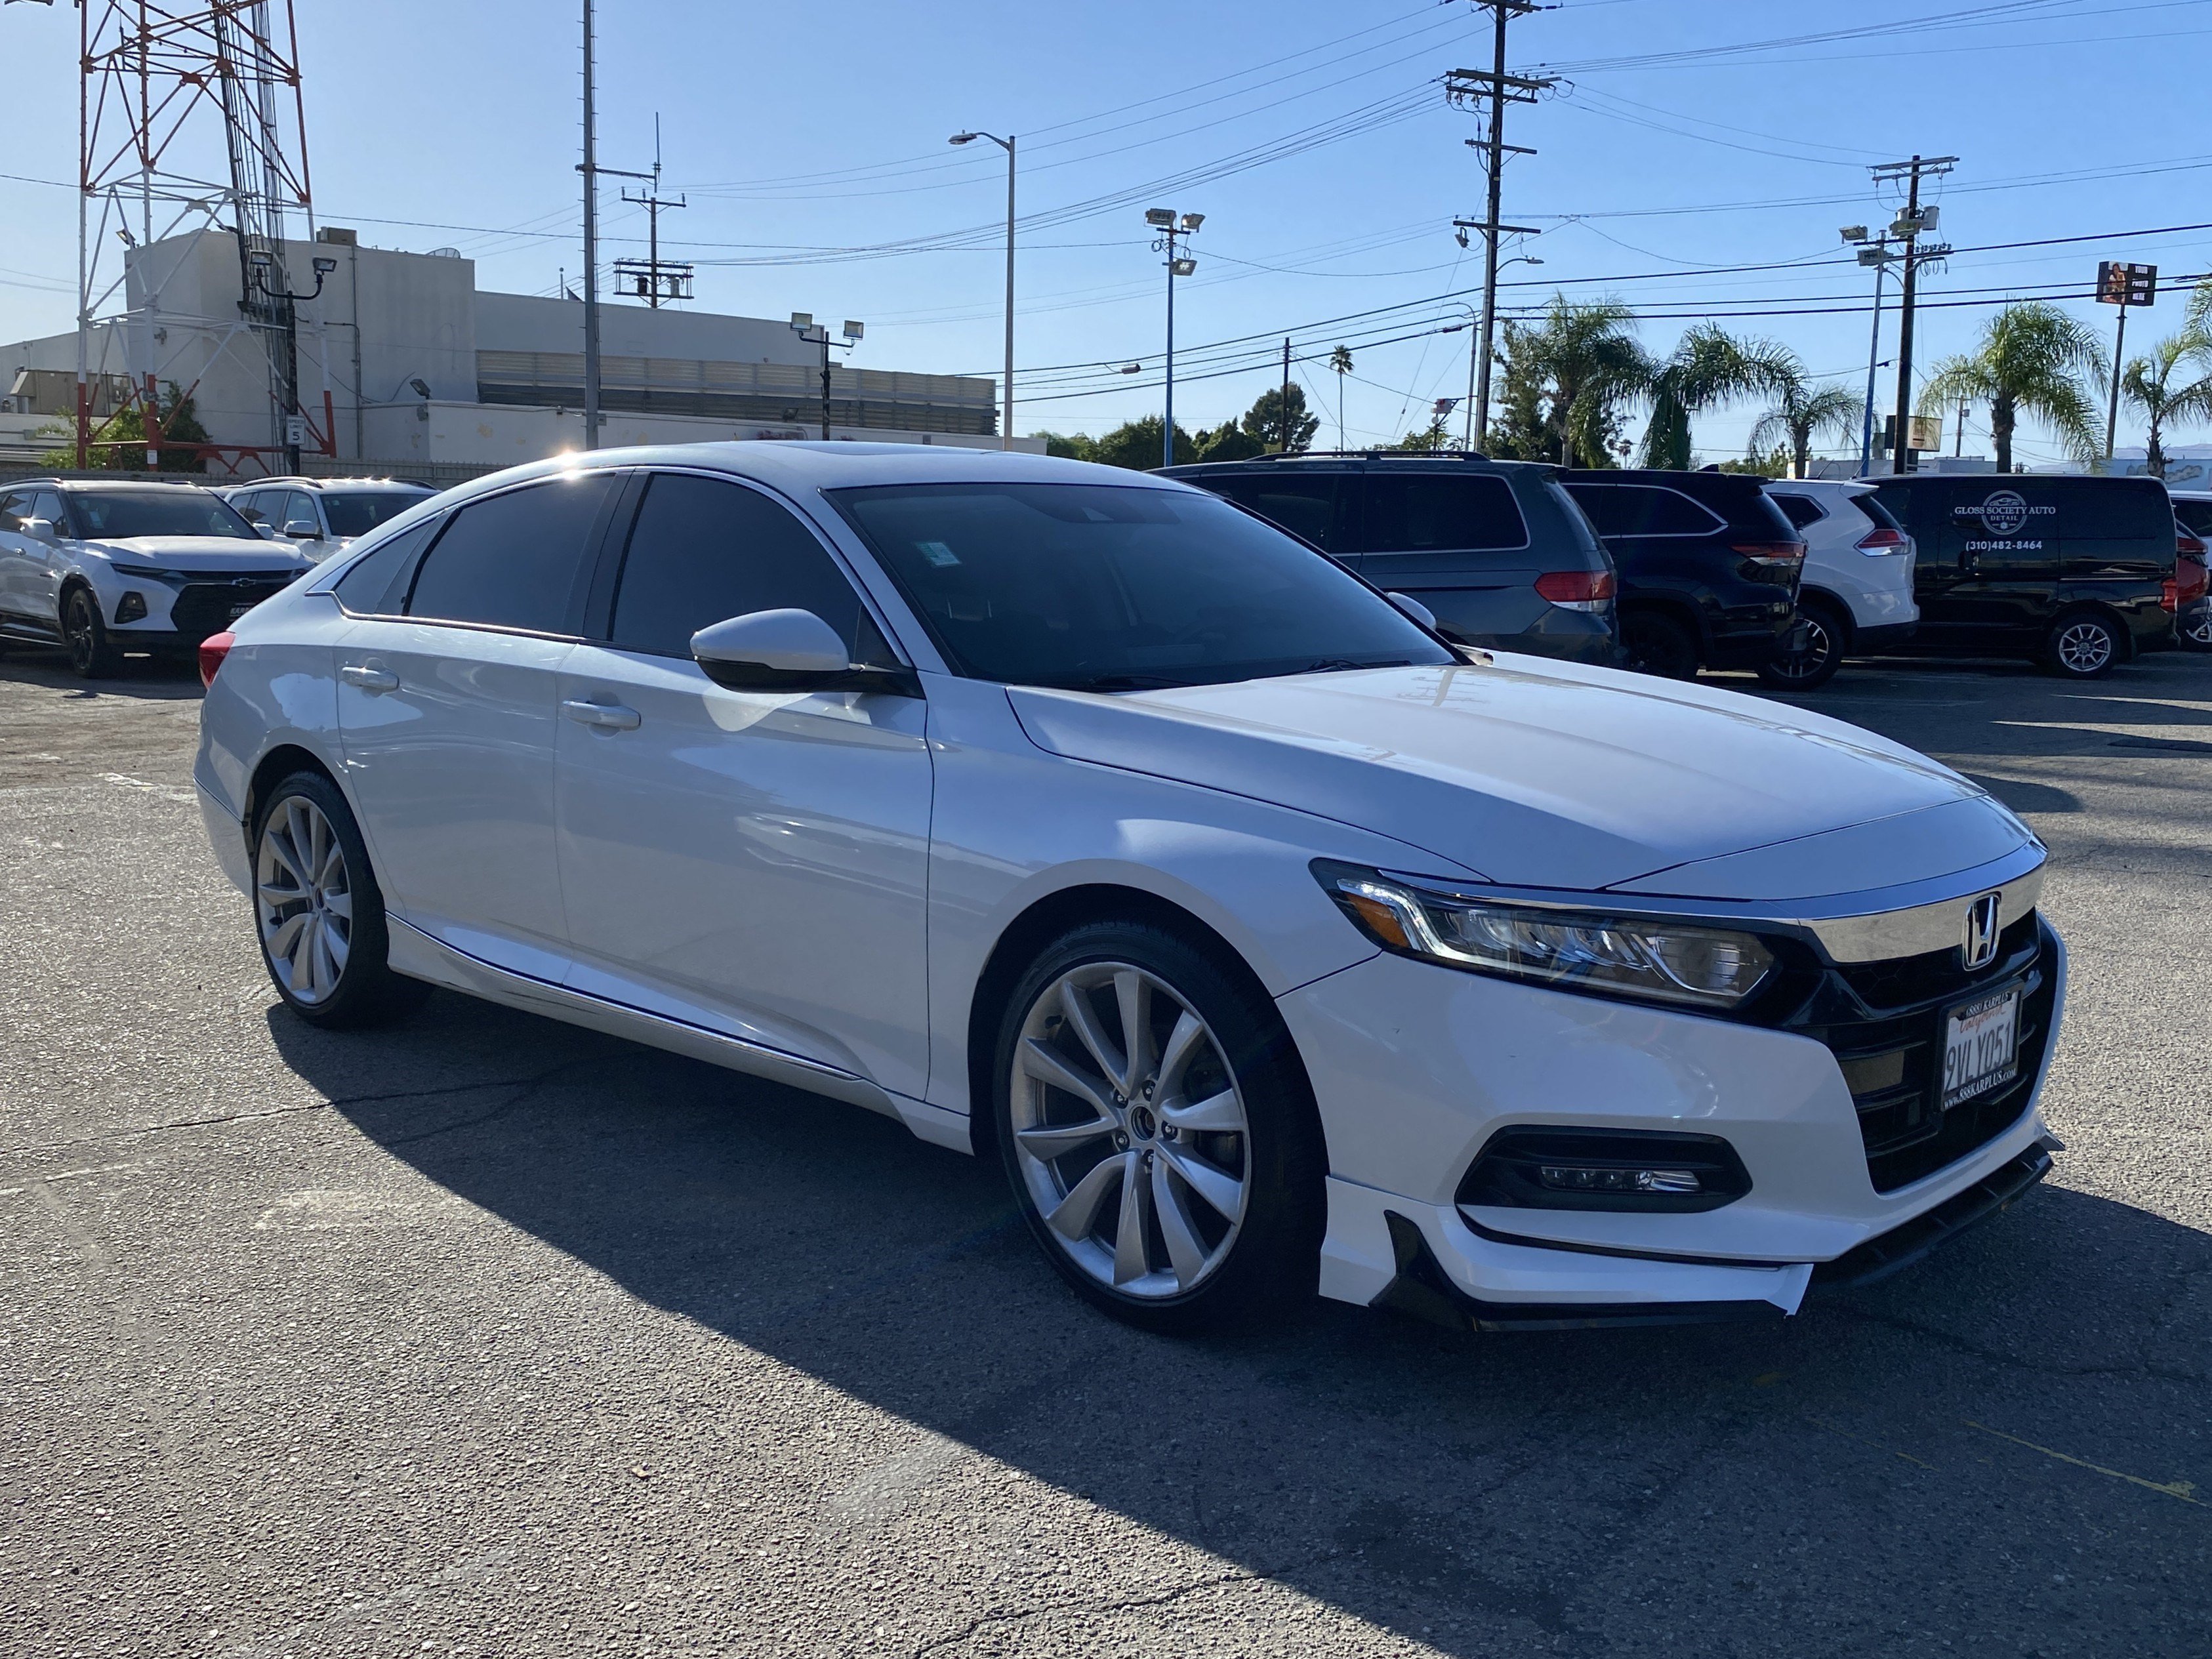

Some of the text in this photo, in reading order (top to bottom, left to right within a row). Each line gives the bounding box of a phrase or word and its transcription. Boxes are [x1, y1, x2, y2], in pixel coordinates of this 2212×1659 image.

[293, 431, 300, 441] 5
[1966, 541, 2043, 552] (310)482-8464
[1982, 991, 2011, 1012] KARPLUS
[1944, 1021, 2011, 1094] 9VLY051
